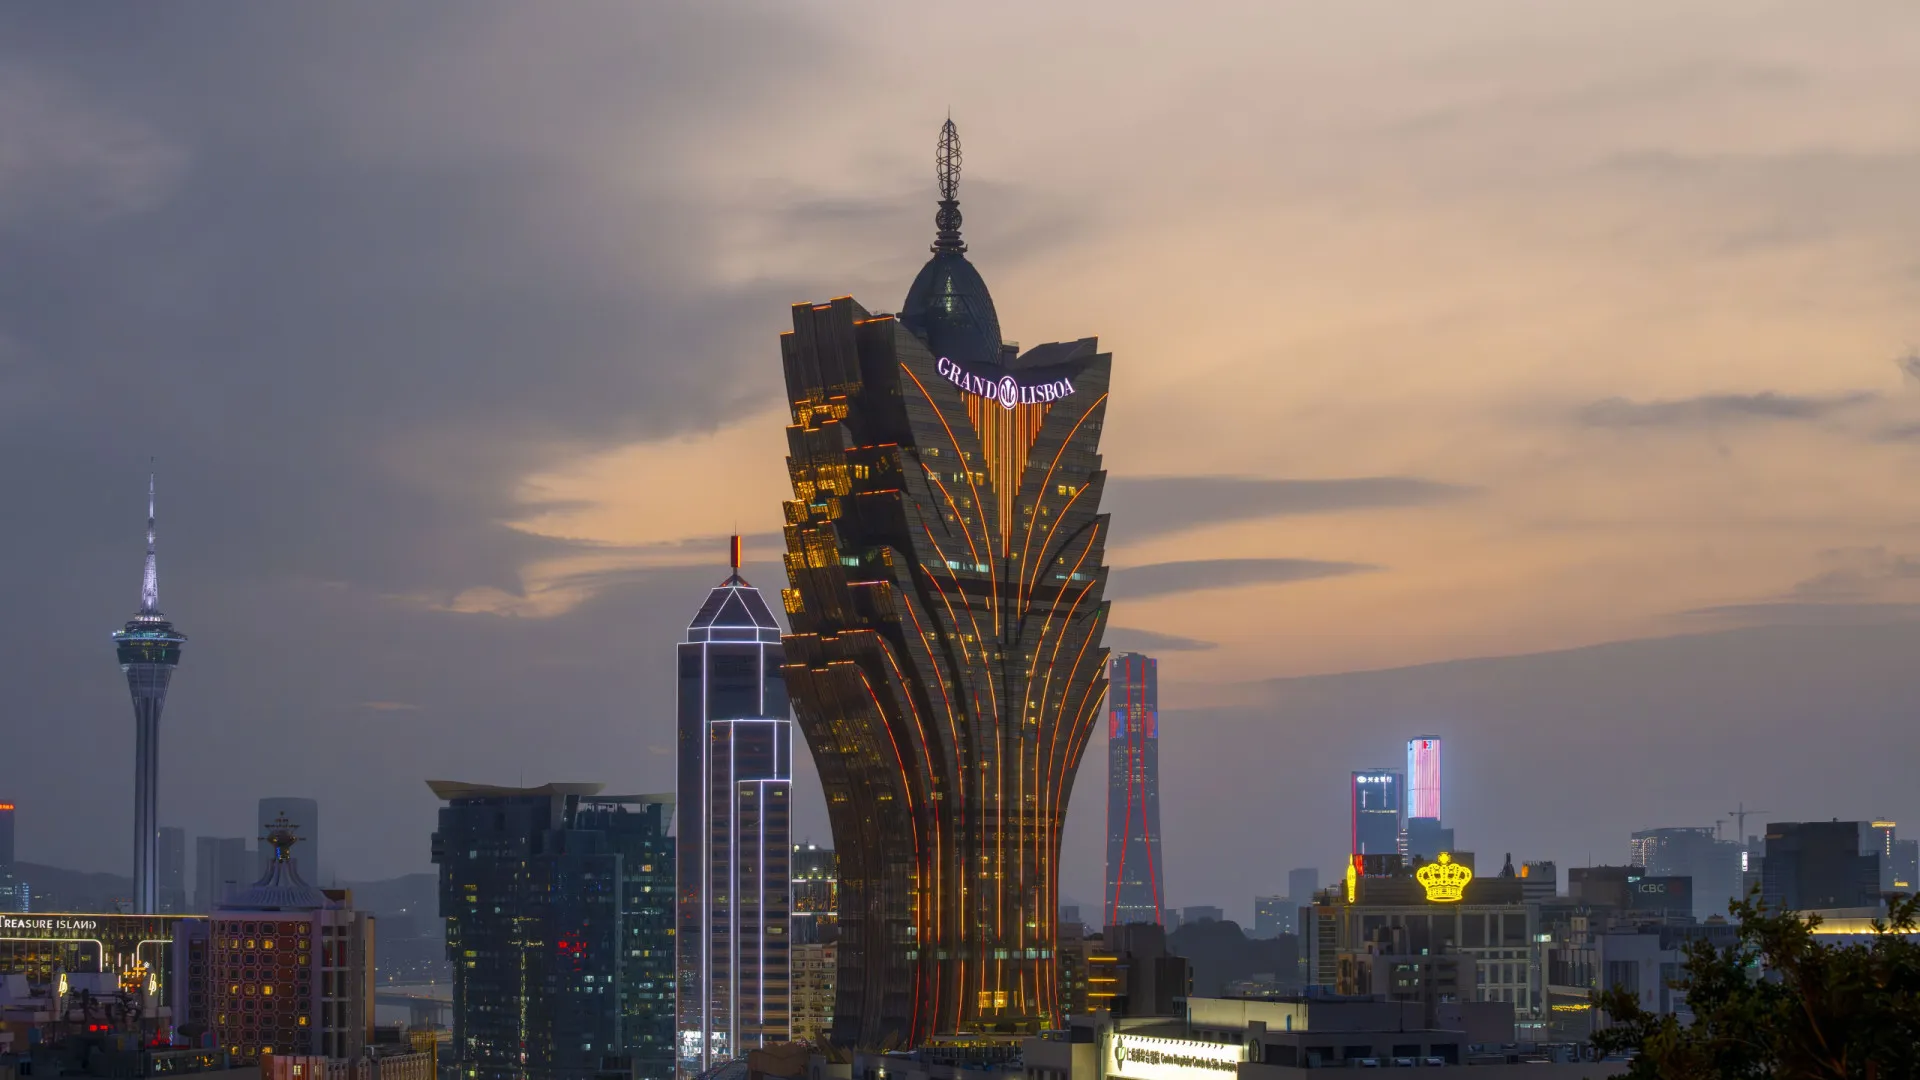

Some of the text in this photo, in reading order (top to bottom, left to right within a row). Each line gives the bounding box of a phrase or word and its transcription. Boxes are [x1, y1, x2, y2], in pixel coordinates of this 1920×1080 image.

[937, 357, 1076, 405] GRAND LISBOA
[1638, 883, 1664, 893] ICBC
[56, 920, 97, 930] ISLAND
